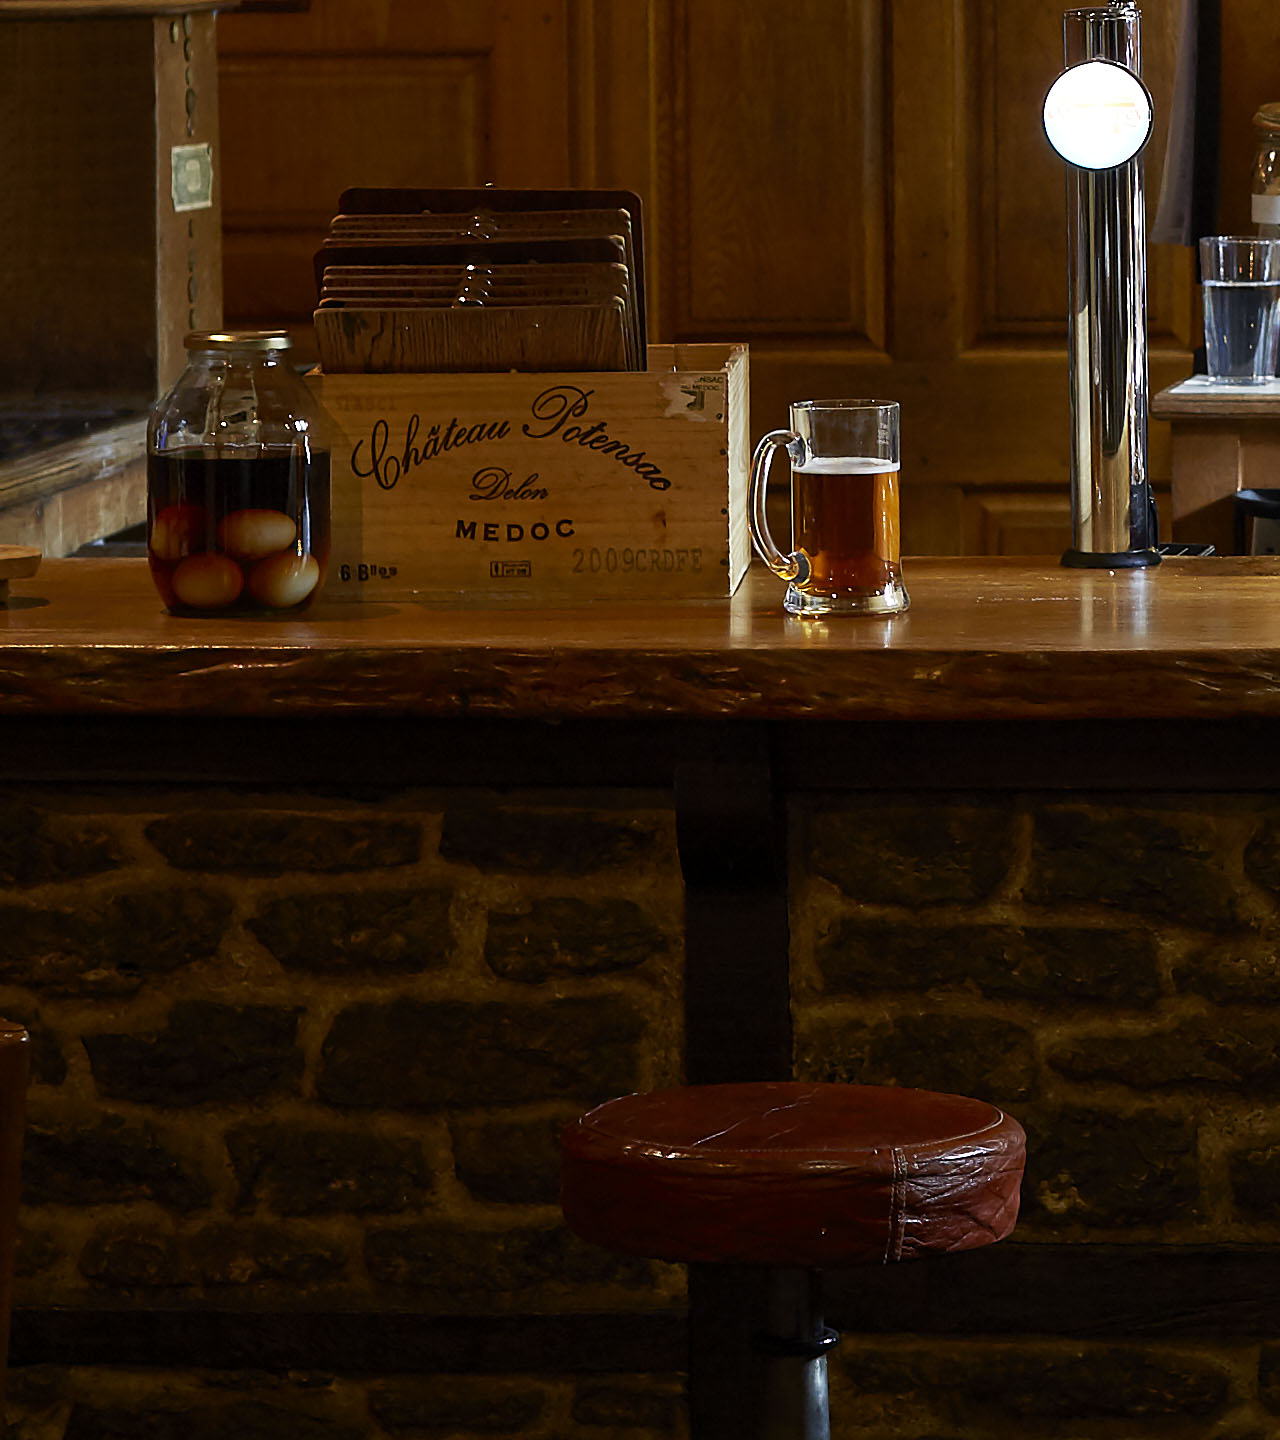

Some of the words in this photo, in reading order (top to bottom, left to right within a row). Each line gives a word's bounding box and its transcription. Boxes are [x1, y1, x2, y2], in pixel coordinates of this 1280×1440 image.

[350, 411, 511, 490] Château
[521, 384, 674, 494] Potensac
[468, 465, 549, 505] Delon
[455, 516, 578, 545] MEDOC
